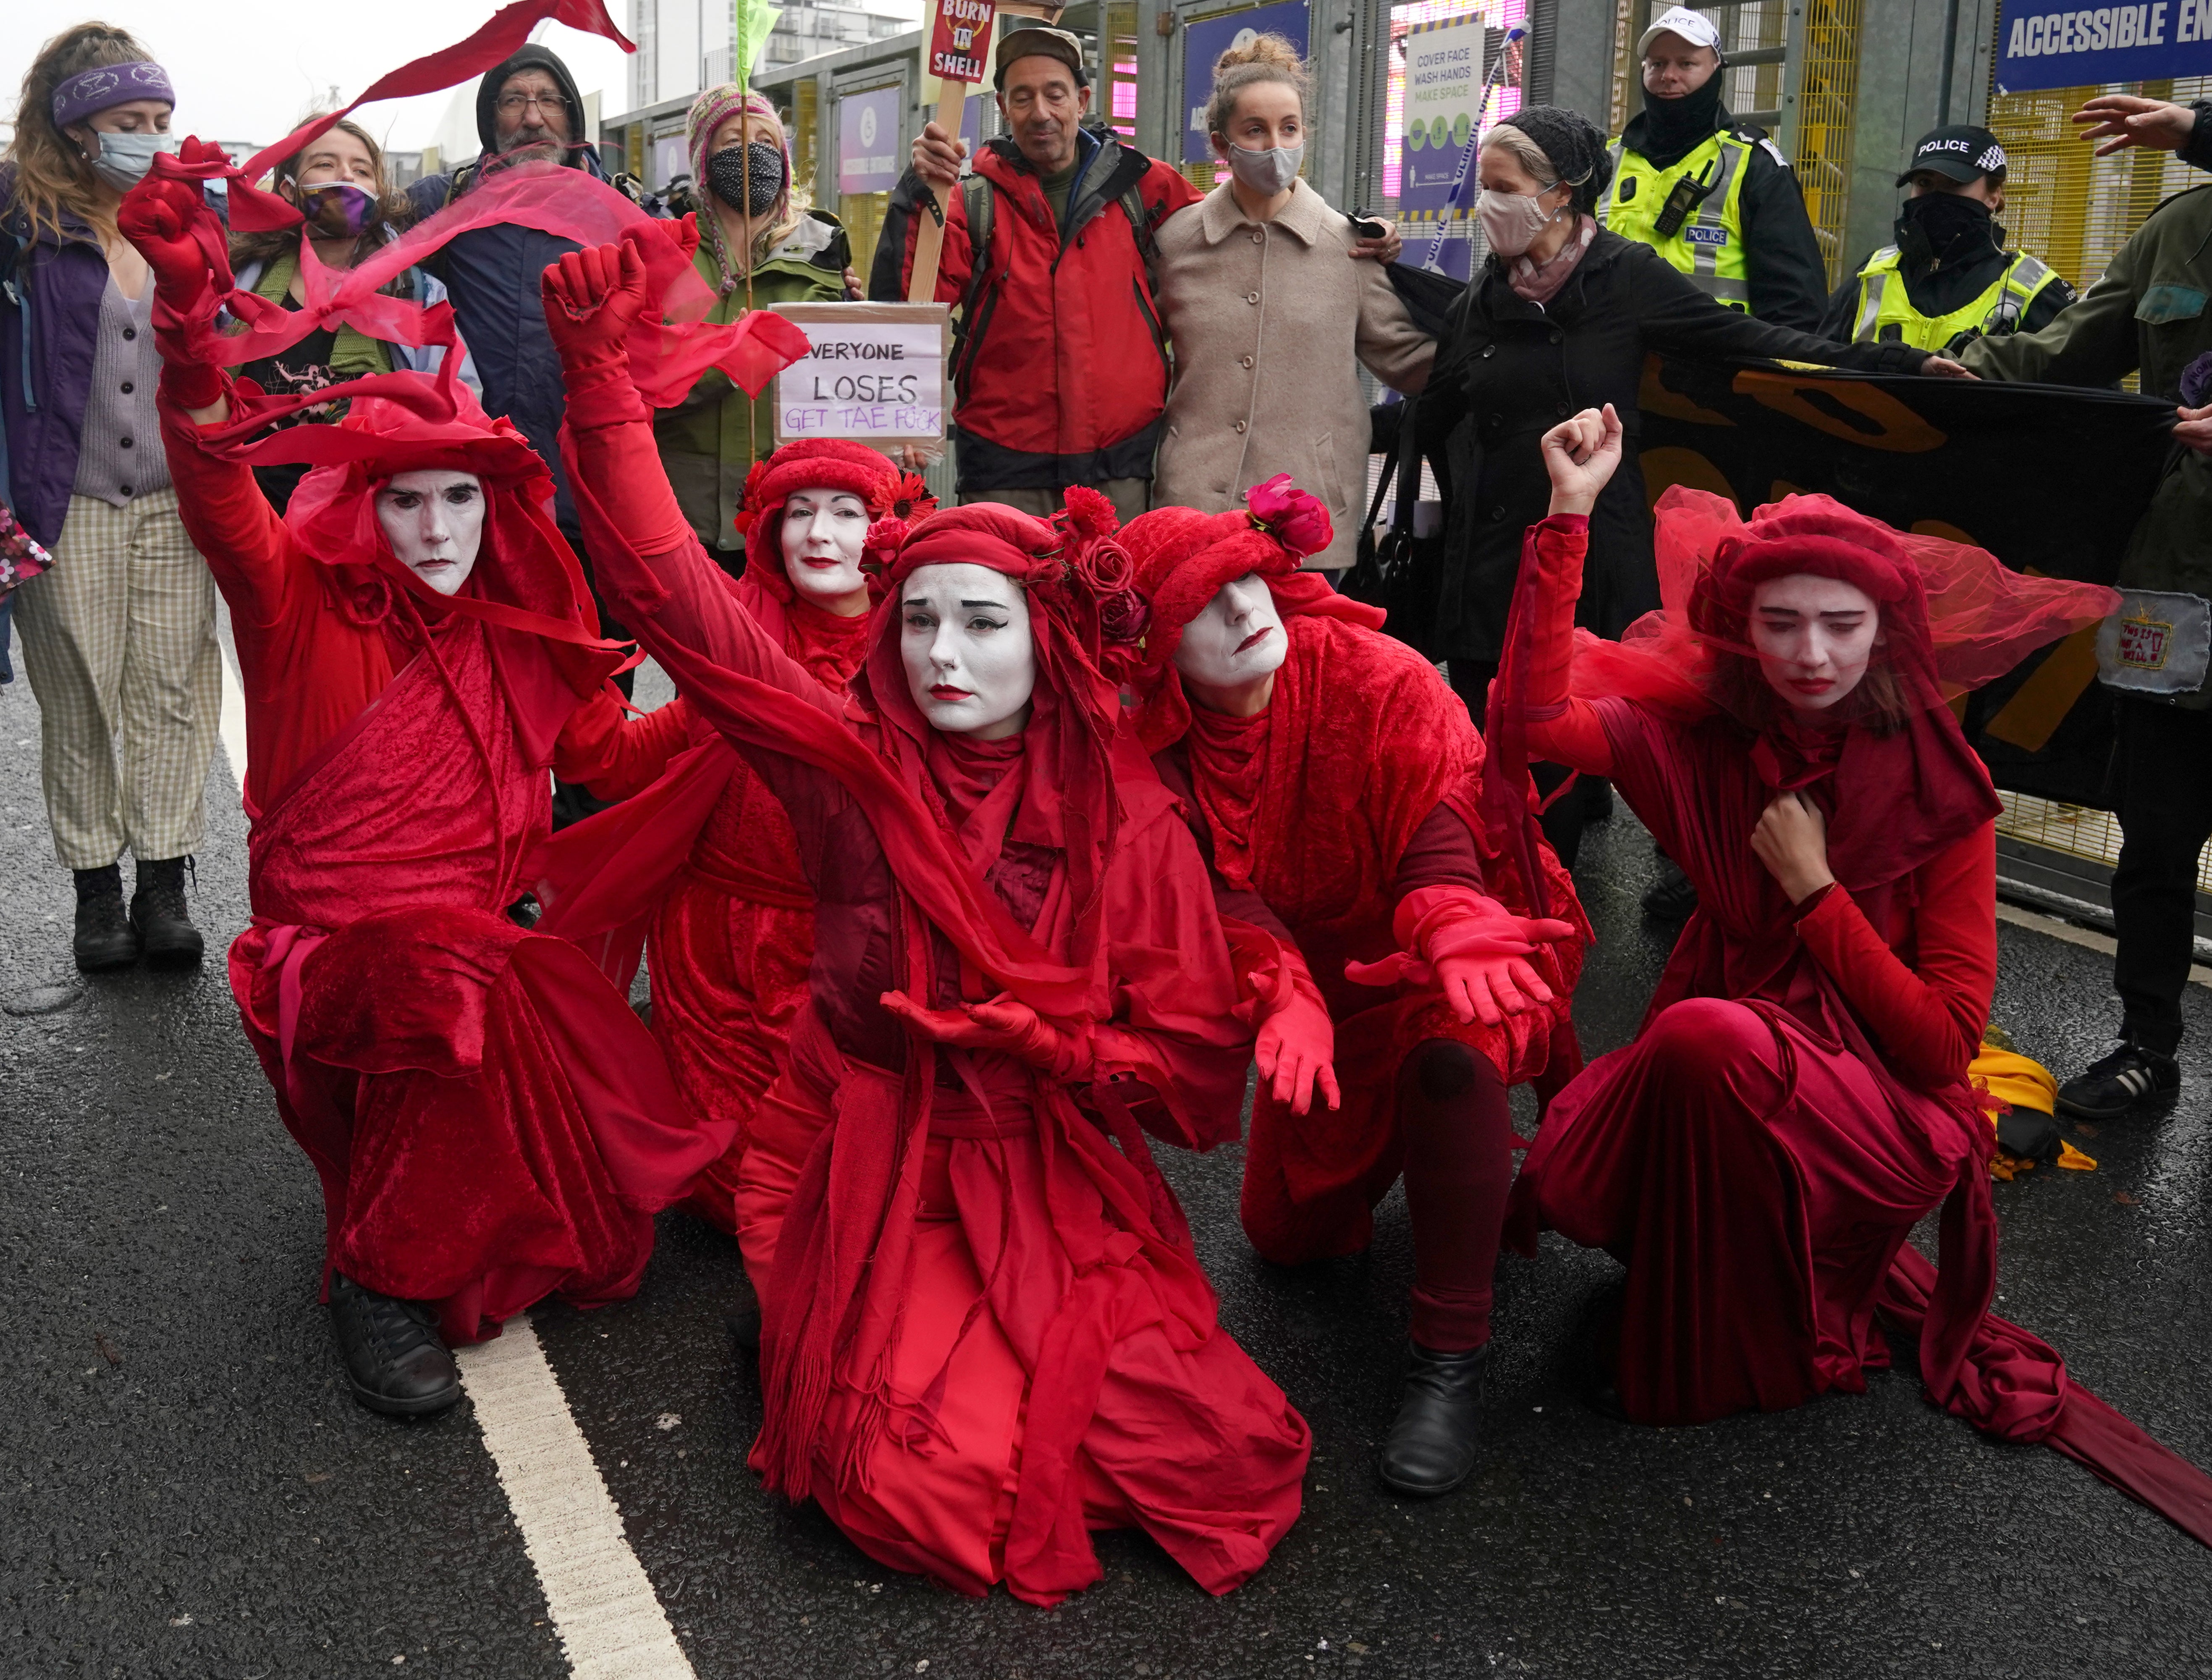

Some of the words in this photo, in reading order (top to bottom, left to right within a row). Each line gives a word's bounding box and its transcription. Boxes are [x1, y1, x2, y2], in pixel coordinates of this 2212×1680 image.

[942, 0, 991, 22] BURN
[954, 29, 973, 49] IN
[2007, 2, 2168, 58] ACCESSIBLE
[934, 52, 980, 78] SHELL
[1418, 52, 1445, 67] COVER
[1447, 47, 1470, 62] FACE
[1415, 71, 1438, 86] WASH
[1440, 66, 1471, 82] HANDS
[1415, 89, 1438, 103] MAKE
[1440, 84, 1469, 100] SPACE
[1918, 139, 1970, 157] POLICE
[1688, 229, 1725, 243] POLICE
[796, 341, 904, 360] VERYONE
[813, 375, 918, 404] LOSES
[785, 408, 828, 432] GET
[837, 406, 888, 429] TAE
[894, 406, 941, 433] FUCK
